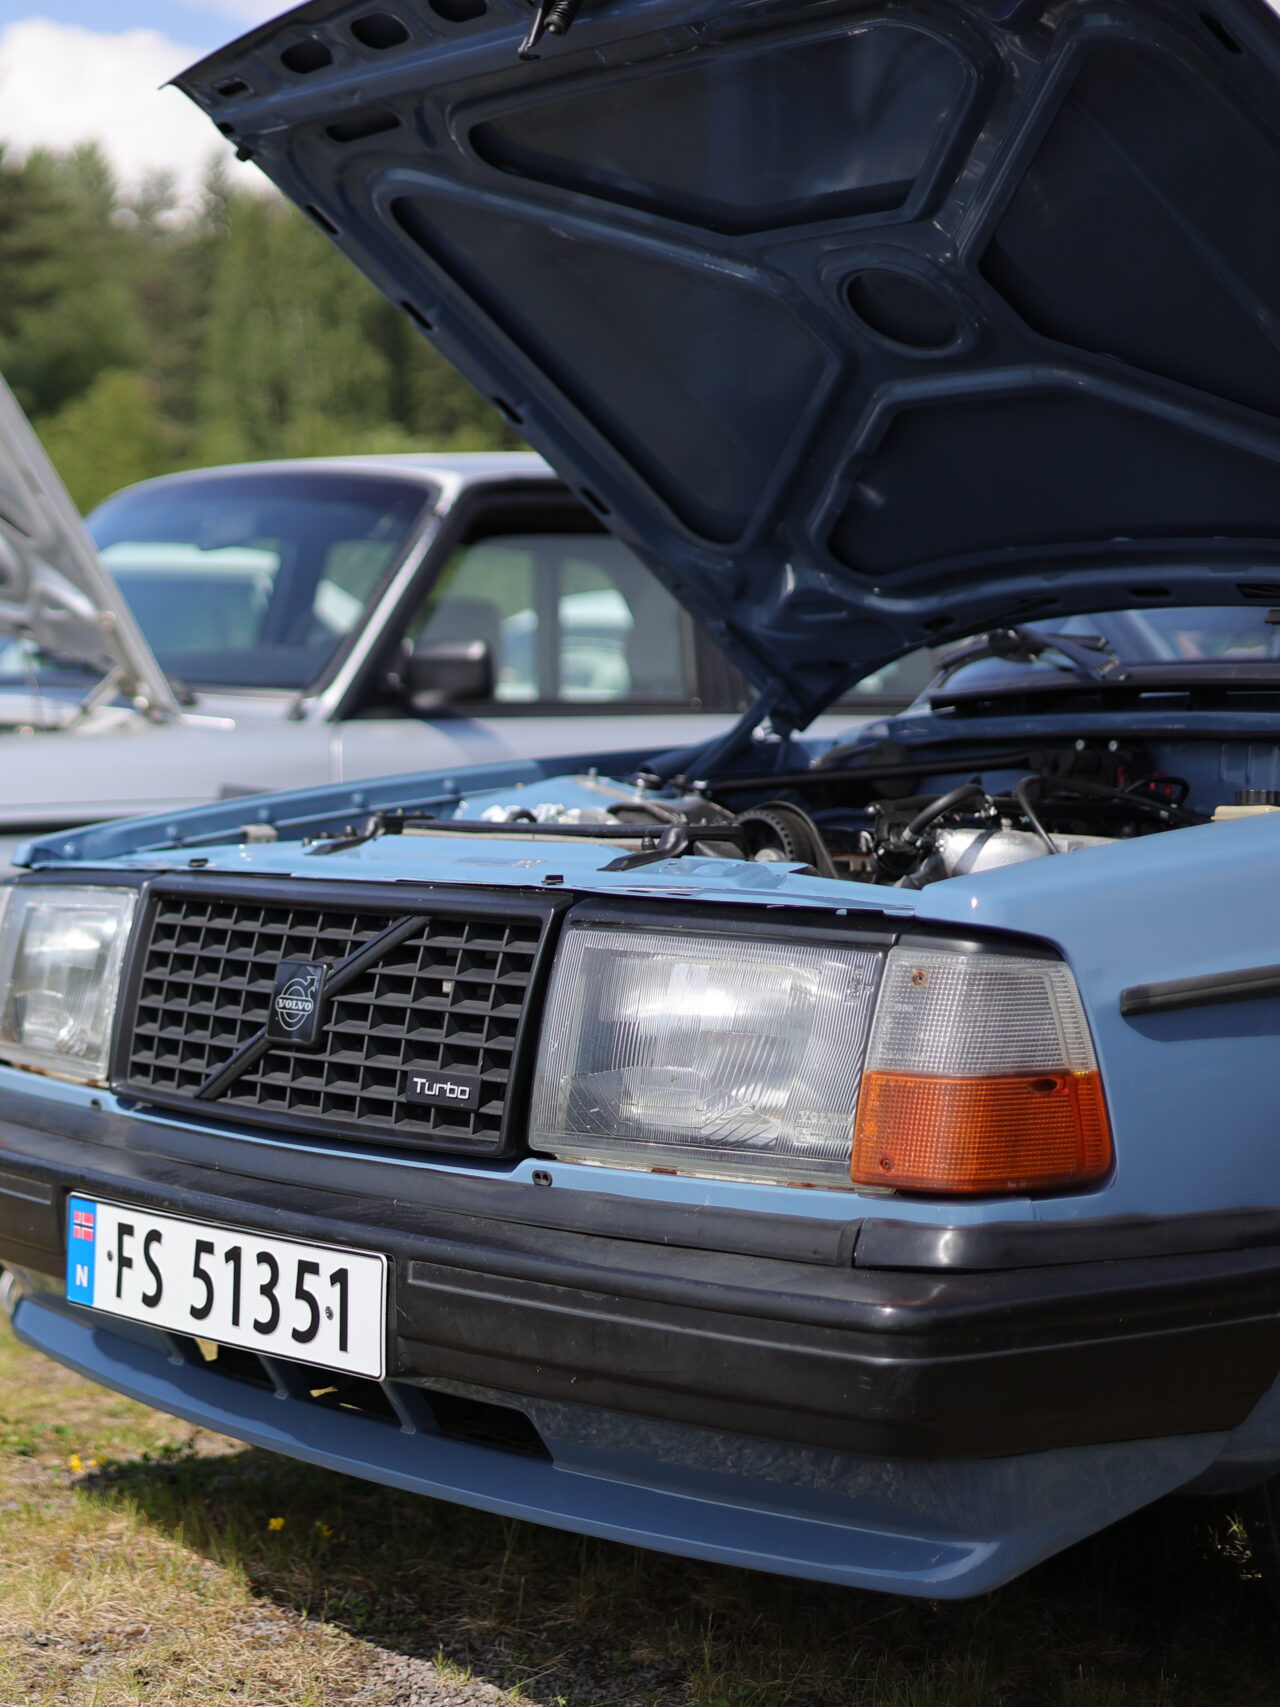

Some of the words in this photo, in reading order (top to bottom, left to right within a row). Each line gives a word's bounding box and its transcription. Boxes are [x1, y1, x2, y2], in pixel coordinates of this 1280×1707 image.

[278, 999, 312, 1011] VOLVO
[413, 1077, 470, 1100] Turbo
[799, 1110, 850, 1125] VOLVO
[74, 1263, 89, 1289] N
[116, 1221, 164, 1309] FS
[189, 1239, 349, 1353] 51351
